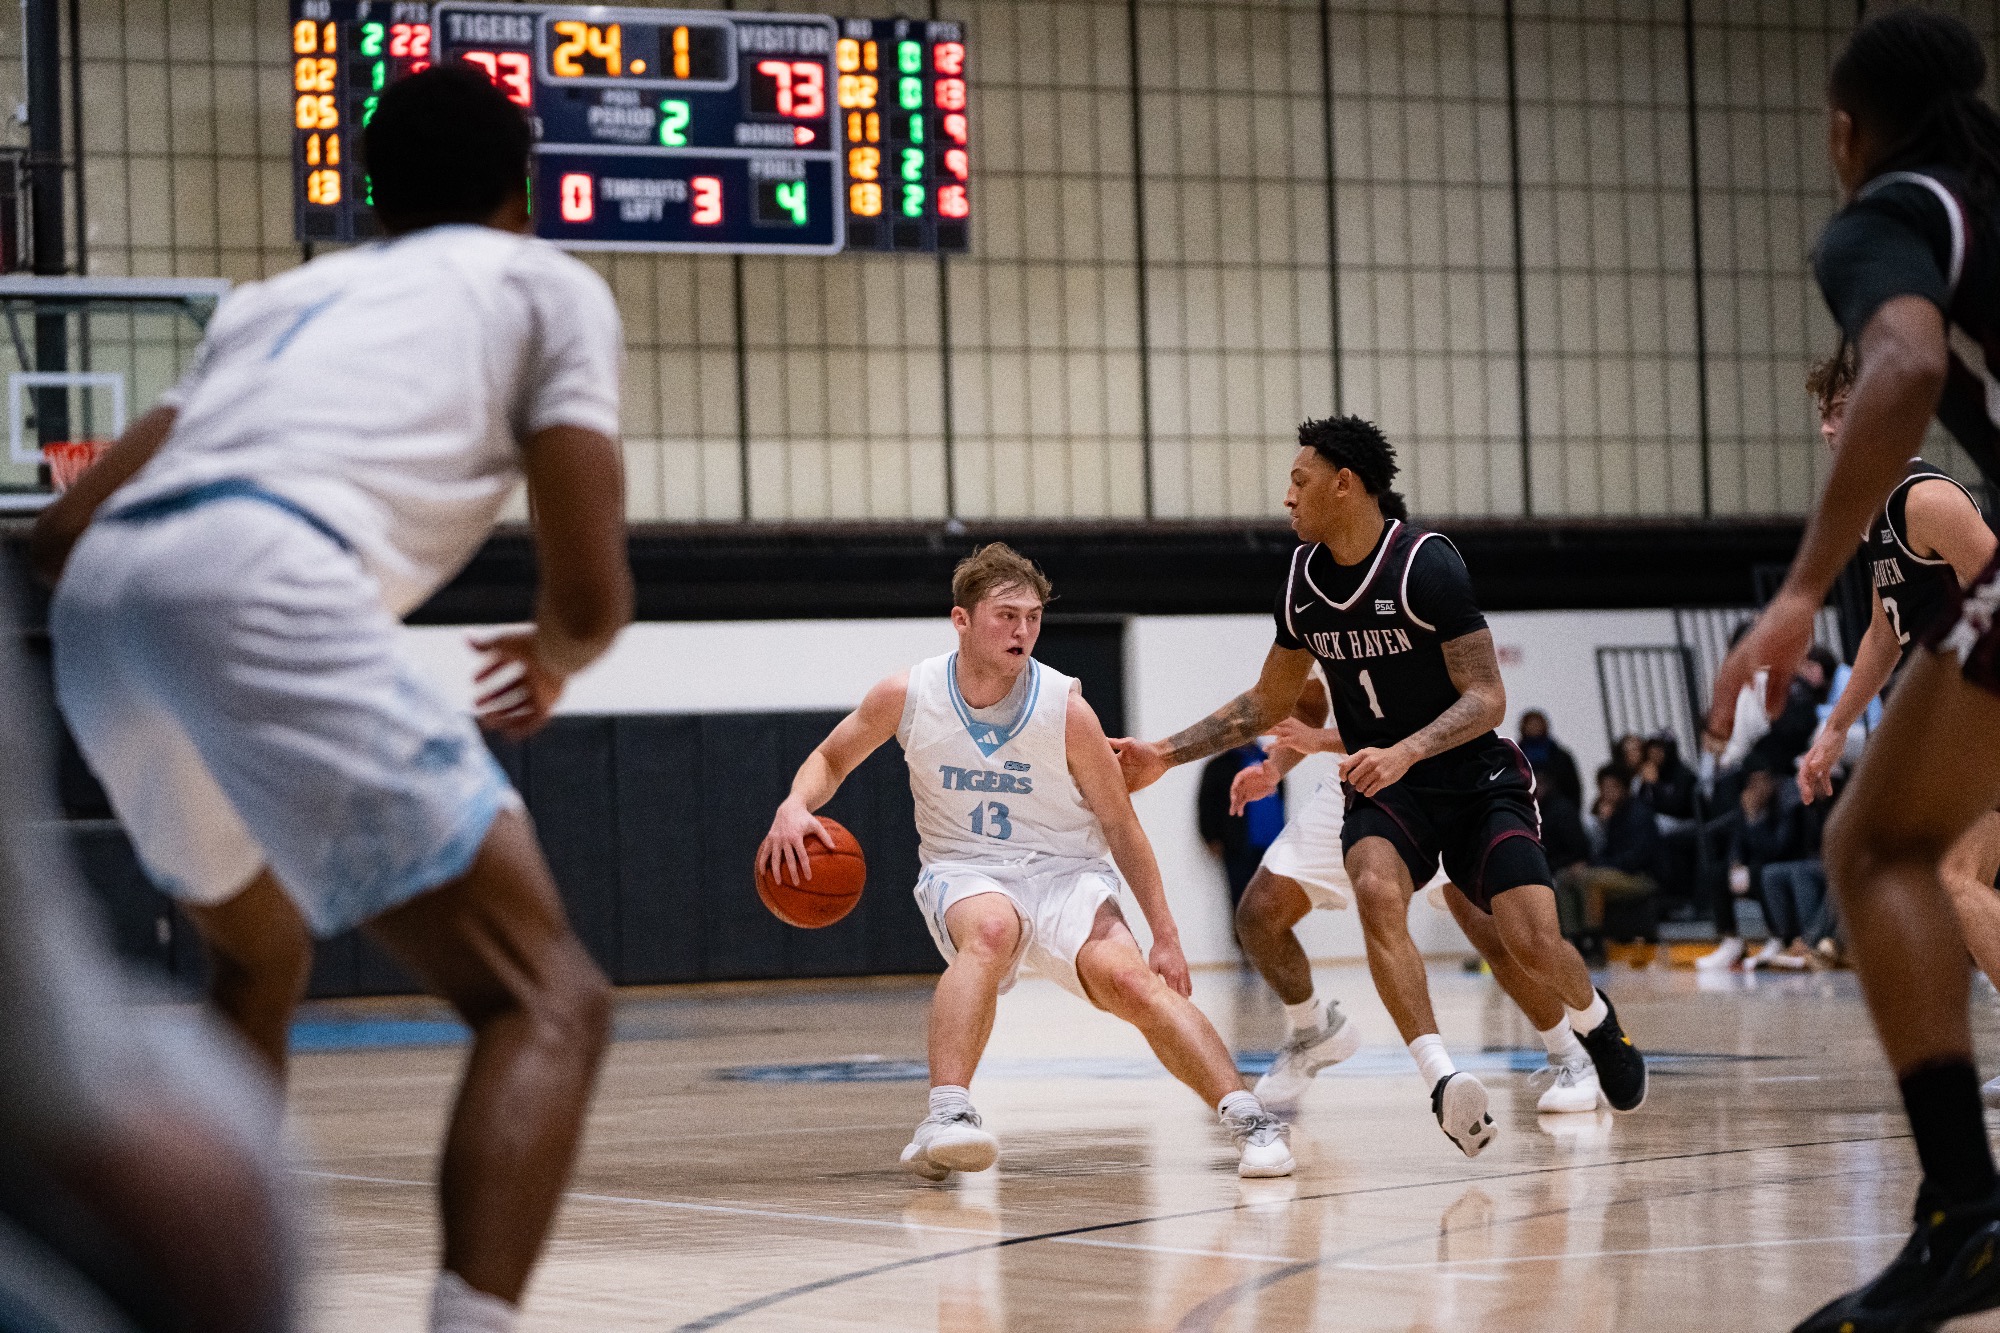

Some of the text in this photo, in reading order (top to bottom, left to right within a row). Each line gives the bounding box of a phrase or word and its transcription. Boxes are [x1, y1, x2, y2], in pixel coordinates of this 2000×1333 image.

[294, 20, 432, 57] 01 2 22
[448, 13, 533, 42] TIGERS
[738, 25, 830, 53] VISITOR
[836, 38, 878, 72] 01
[897, 40, 921, 74] 0
[295, 57, 385, 92] 02 1
[757, 60, 825, 118] 73
[837, 74, 879, 109] 02
[899, 76, 922, 110] 0
[296, 94, 339, 129] 05
[660, 99, 690, 146] 2
[847, 111, 880, 143] 11
[909, 113, 923, 144] 1
[307, 133, 340, 166] 11
[901, 147, 924, 181] 2
[308, 170, 341, 204] 13
[561, 173, 593, 223] 0
[691, 176, 722, 225] 3
[776, 181, 807, 224] 4
[902, 183, 925, 217] 2
[1882, 597, 1911, 646] 2
[1304, 628, 1412, 660] LOCK HAVEN
[1359, 669, 1385, 719] 1
[939, 765, 1033, 795] TIGERS
[968, 800, 1013, 840] 13
